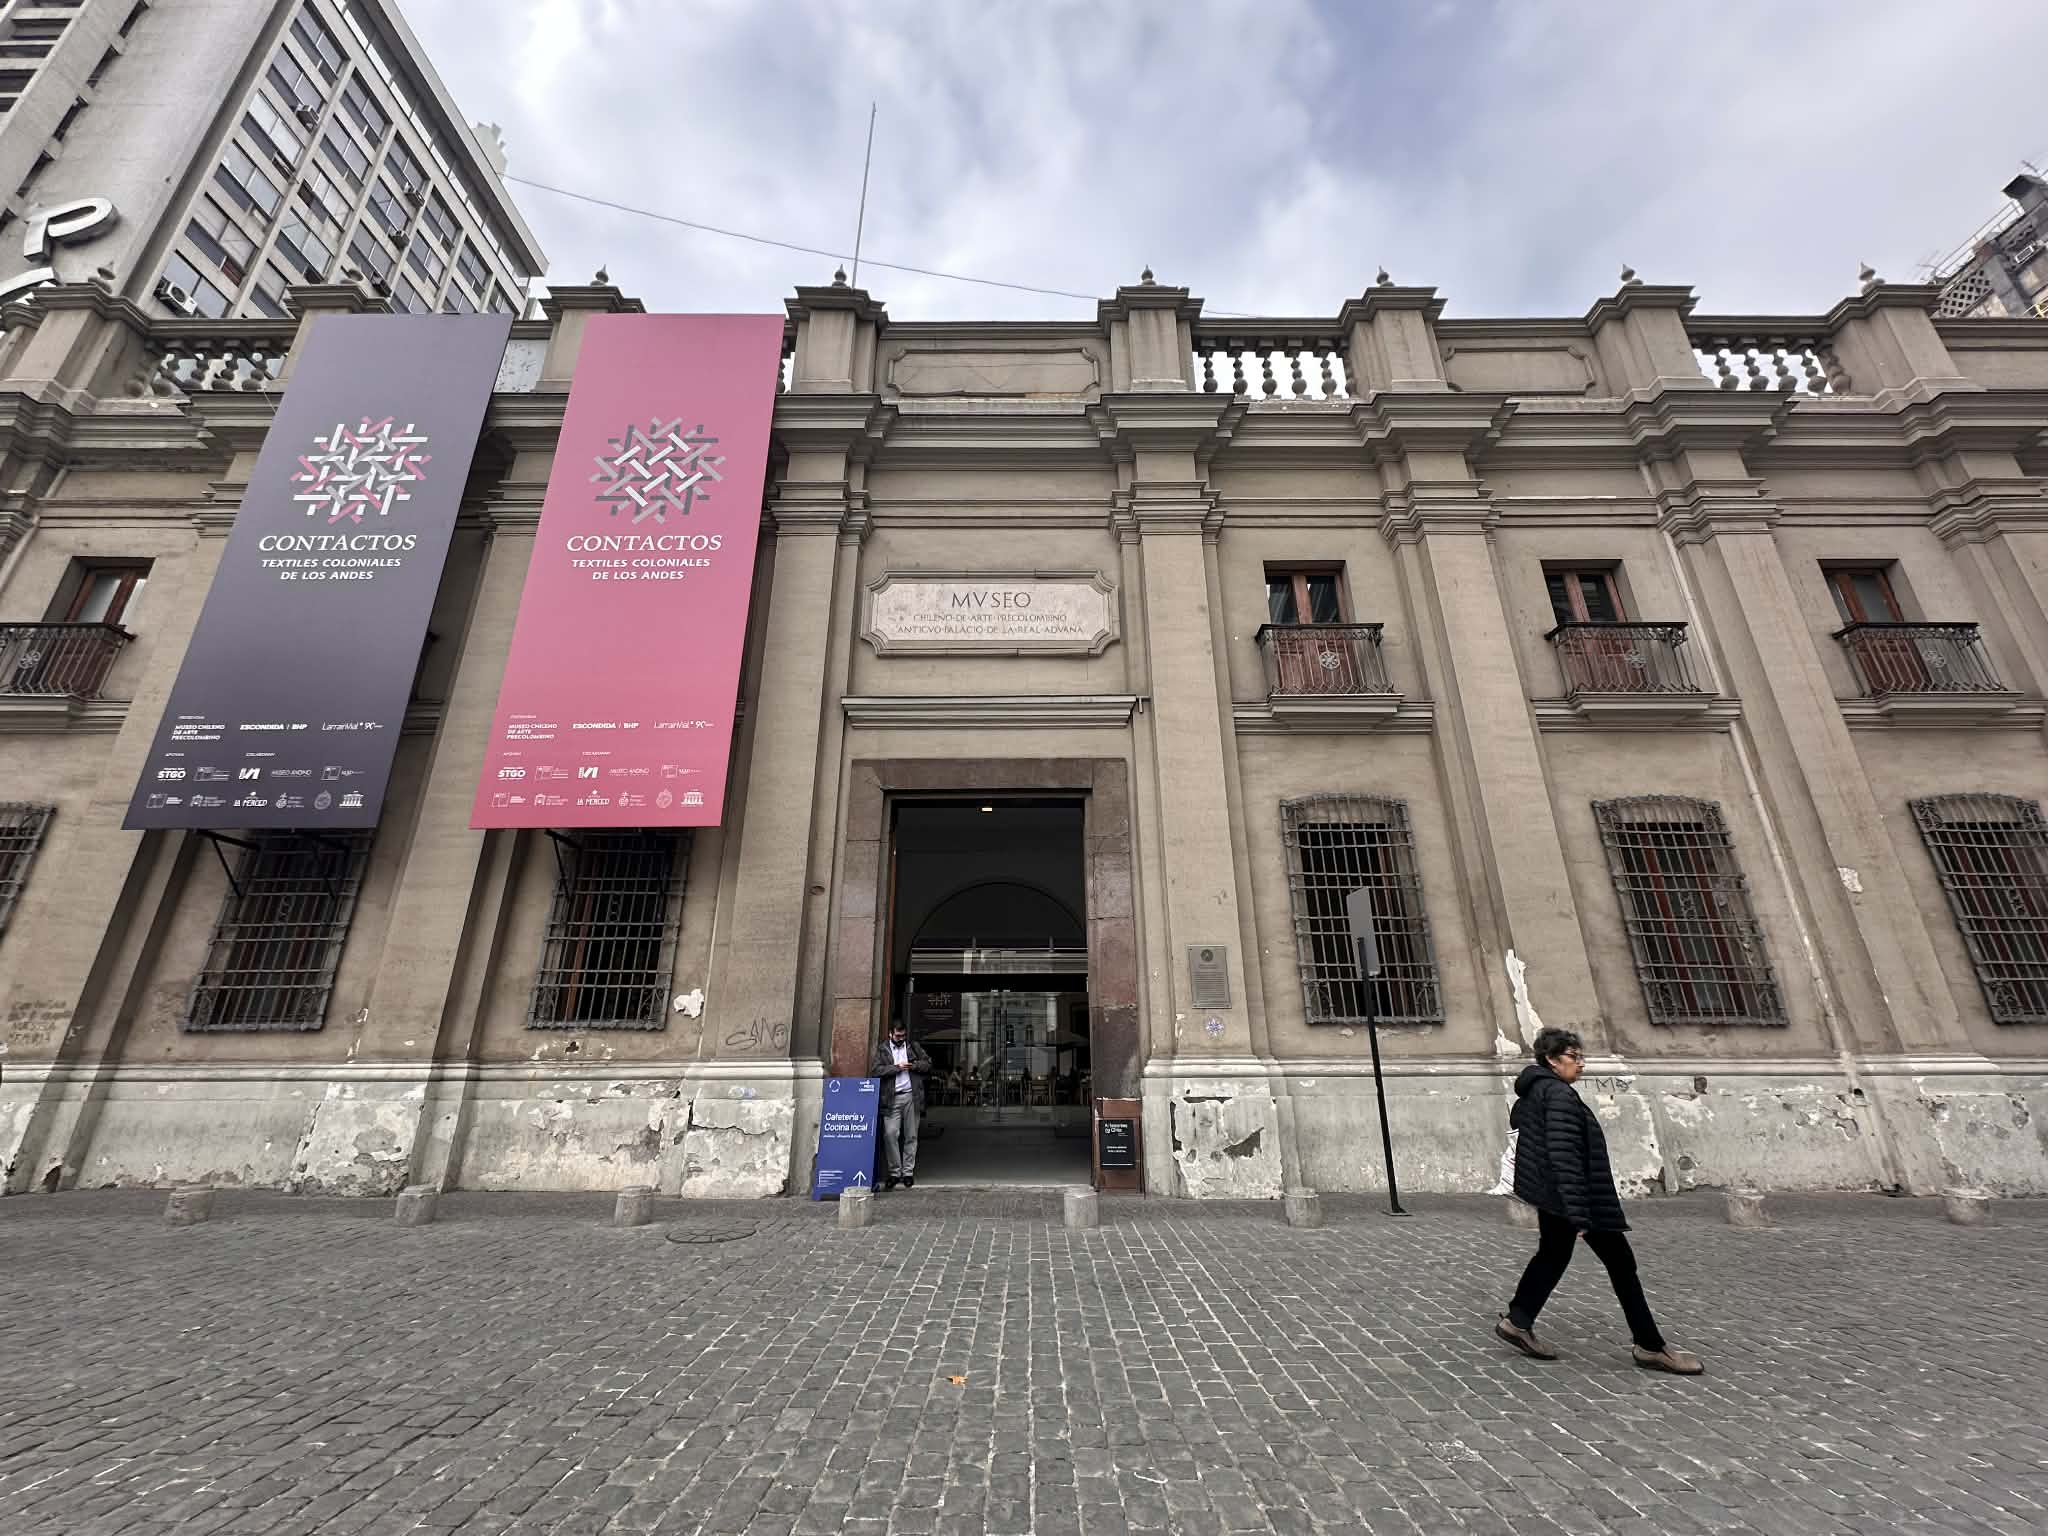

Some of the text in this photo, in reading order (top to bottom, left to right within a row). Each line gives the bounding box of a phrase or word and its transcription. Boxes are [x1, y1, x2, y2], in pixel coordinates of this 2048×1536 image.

[258, 534, 417, 551] CONTACTOS
[566, 534, 723, 551] CONTACTOS
[261, 558, 401, 568] TEXTILES COLONIALES
[571, 558, 711, 568] TEXTILES COLONIALES
[280, 571, 374, 580] DE LOS ANDES
[592, 571, 685, 580] DE LOS ANDES
[951, 591, 1032, 608] MVSEO
[157, 770, 186, 779] STGO
[497, 769, 526, 778] STGO
[824, 1122, 868, 1132] Cocina local
